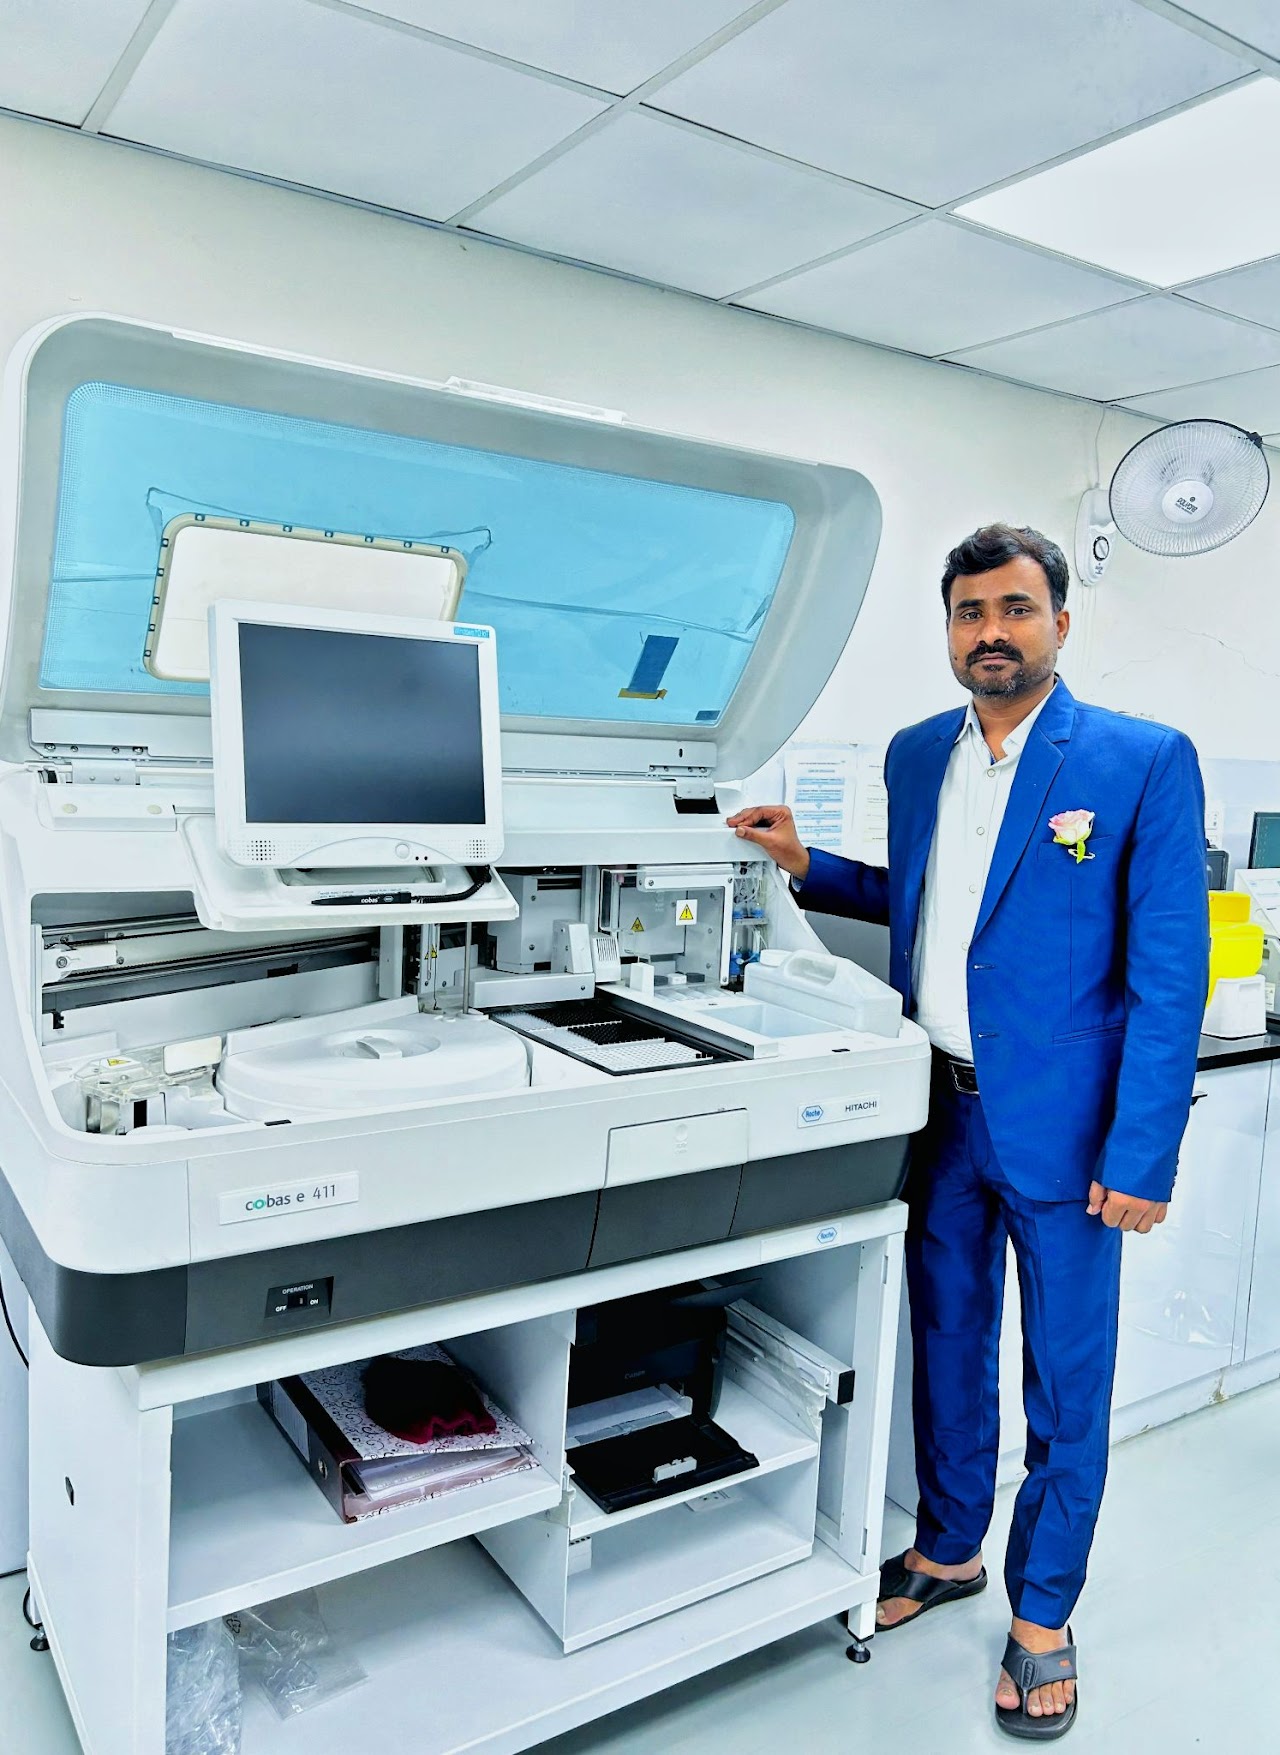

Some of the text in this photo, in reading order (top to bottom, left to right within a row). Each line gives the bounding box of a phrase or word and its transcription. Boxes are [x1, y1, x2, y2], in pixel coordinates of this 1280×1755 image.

[845, 1100, 878, 1112] HITACHI
[805, 1108, 821, 1118] Roche
[245, 1184, 336, 1211] cobas e 411
[282, 1284, 314, 1294] OPERATION
